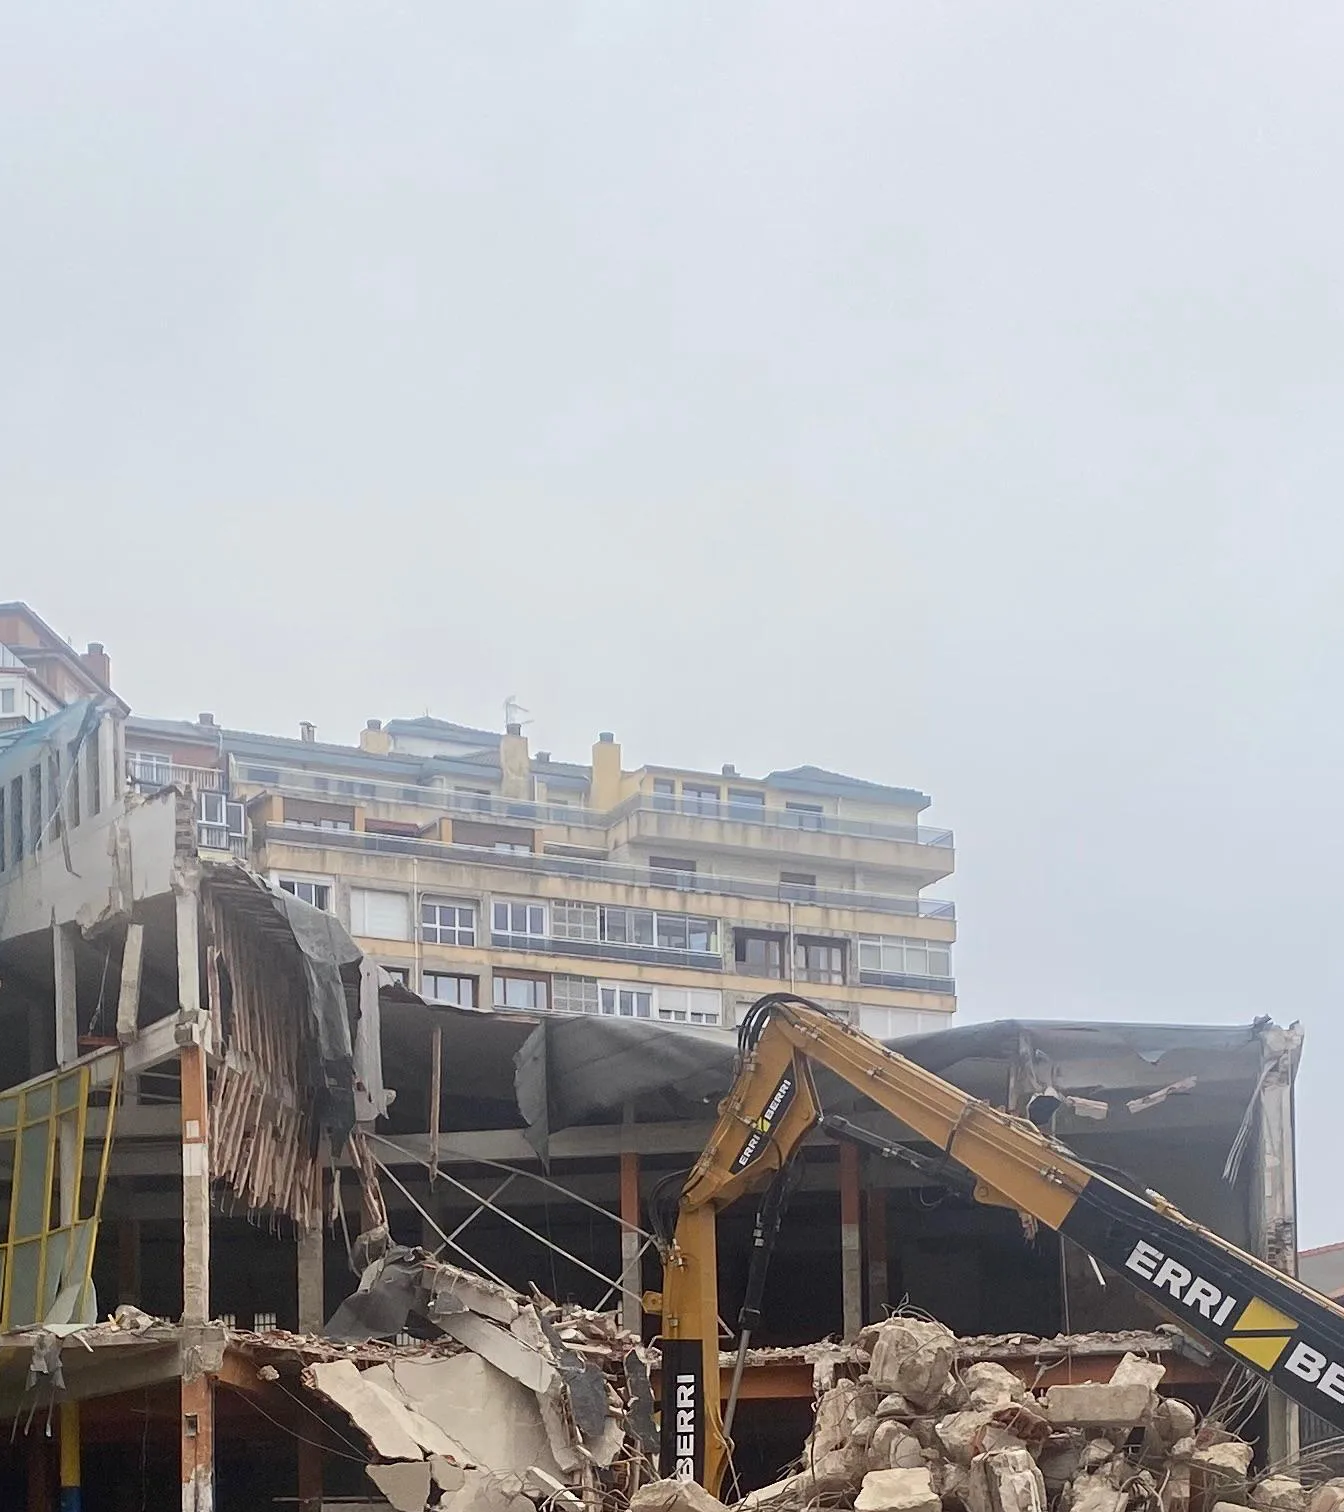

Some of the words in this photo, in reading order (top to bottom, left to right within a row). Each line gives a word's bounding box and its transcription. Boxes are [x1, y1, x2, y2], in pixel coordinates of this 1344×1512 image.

[738, 1134, 761, 1166] ERRI
[764, 1079, 791, 1120] BERRI
[1124, 1240, 1237, 1326] ERRI
[676, 1374, 695, 1480] BERRI
